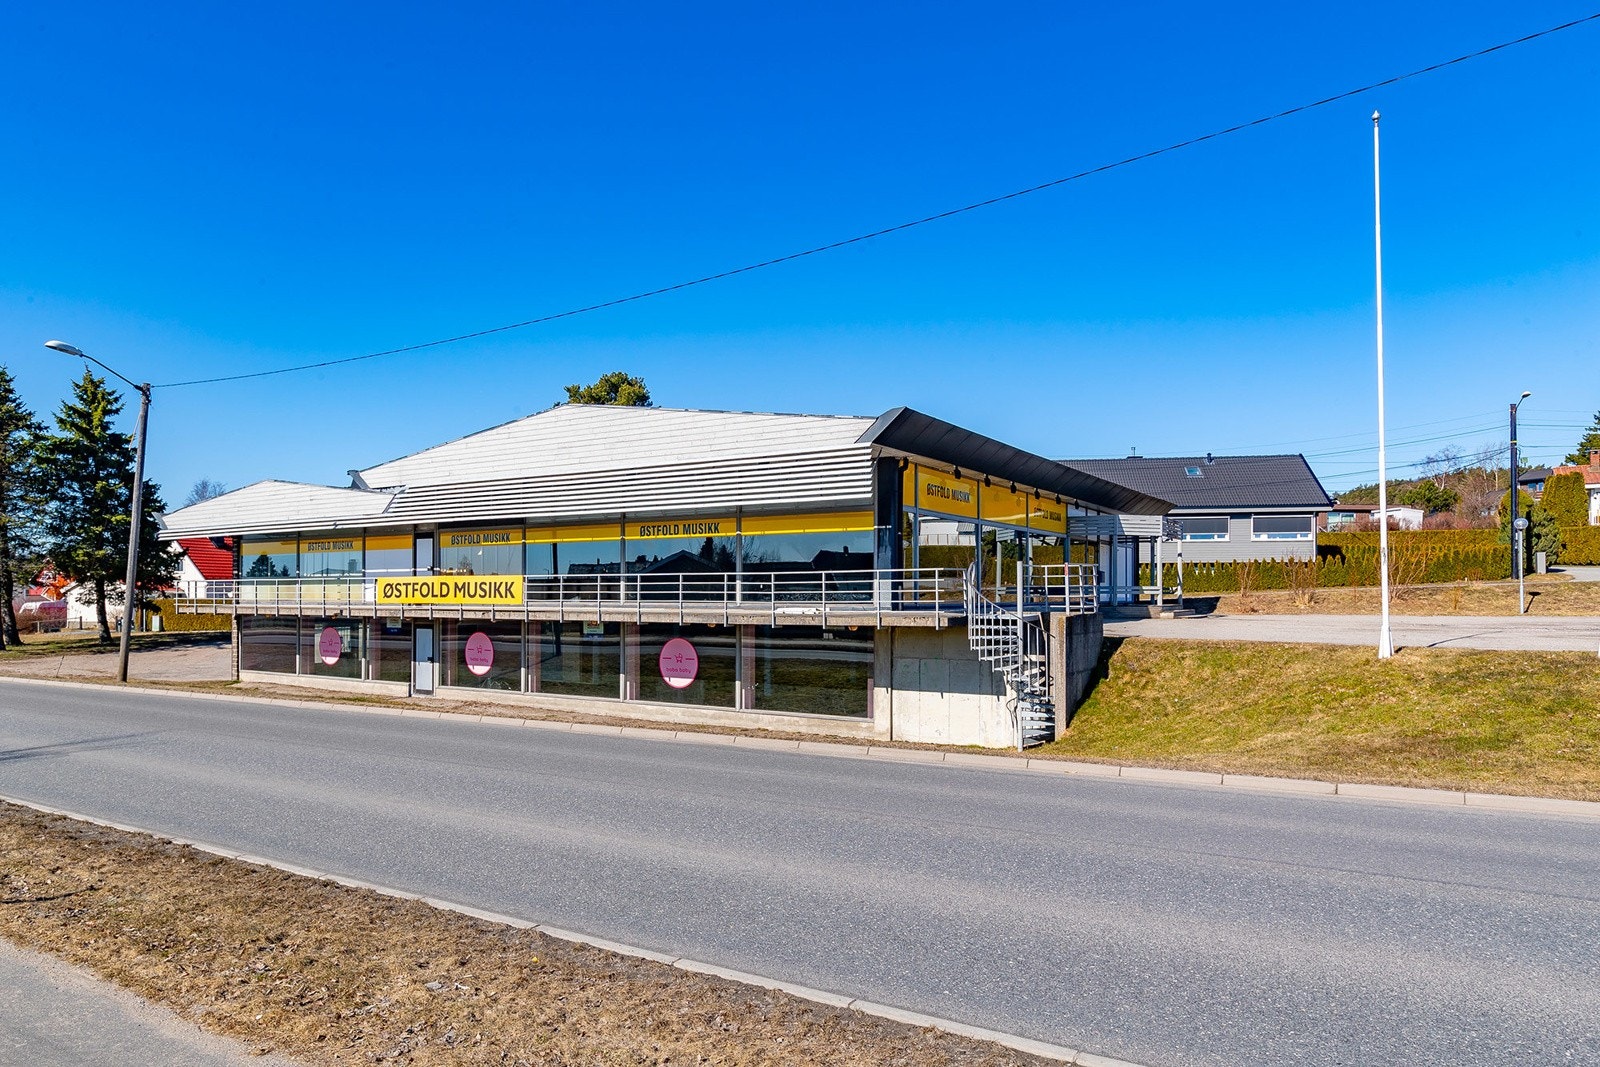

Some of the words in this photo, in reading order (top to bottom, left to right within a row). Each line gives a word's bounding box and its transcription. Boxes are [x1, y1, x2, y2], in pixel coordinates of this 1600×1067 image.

[926, 483, 950, 499] ØSTFOLD
[640, 524, 680, 537] ØSTFOLD
[682, 522, 720, 535] MUSIKK
[307, 541, 331, 551] ØSTFOLD
[332, 540, 354, 550] MUSIKK
[451, 534, 481, 545] ØSTFOLD
[482, 533, 511, 543] MUSIKK
[383, 581, 450, 599] ØSTFOLD
[454, 581, 515, 599] MUSIKK
